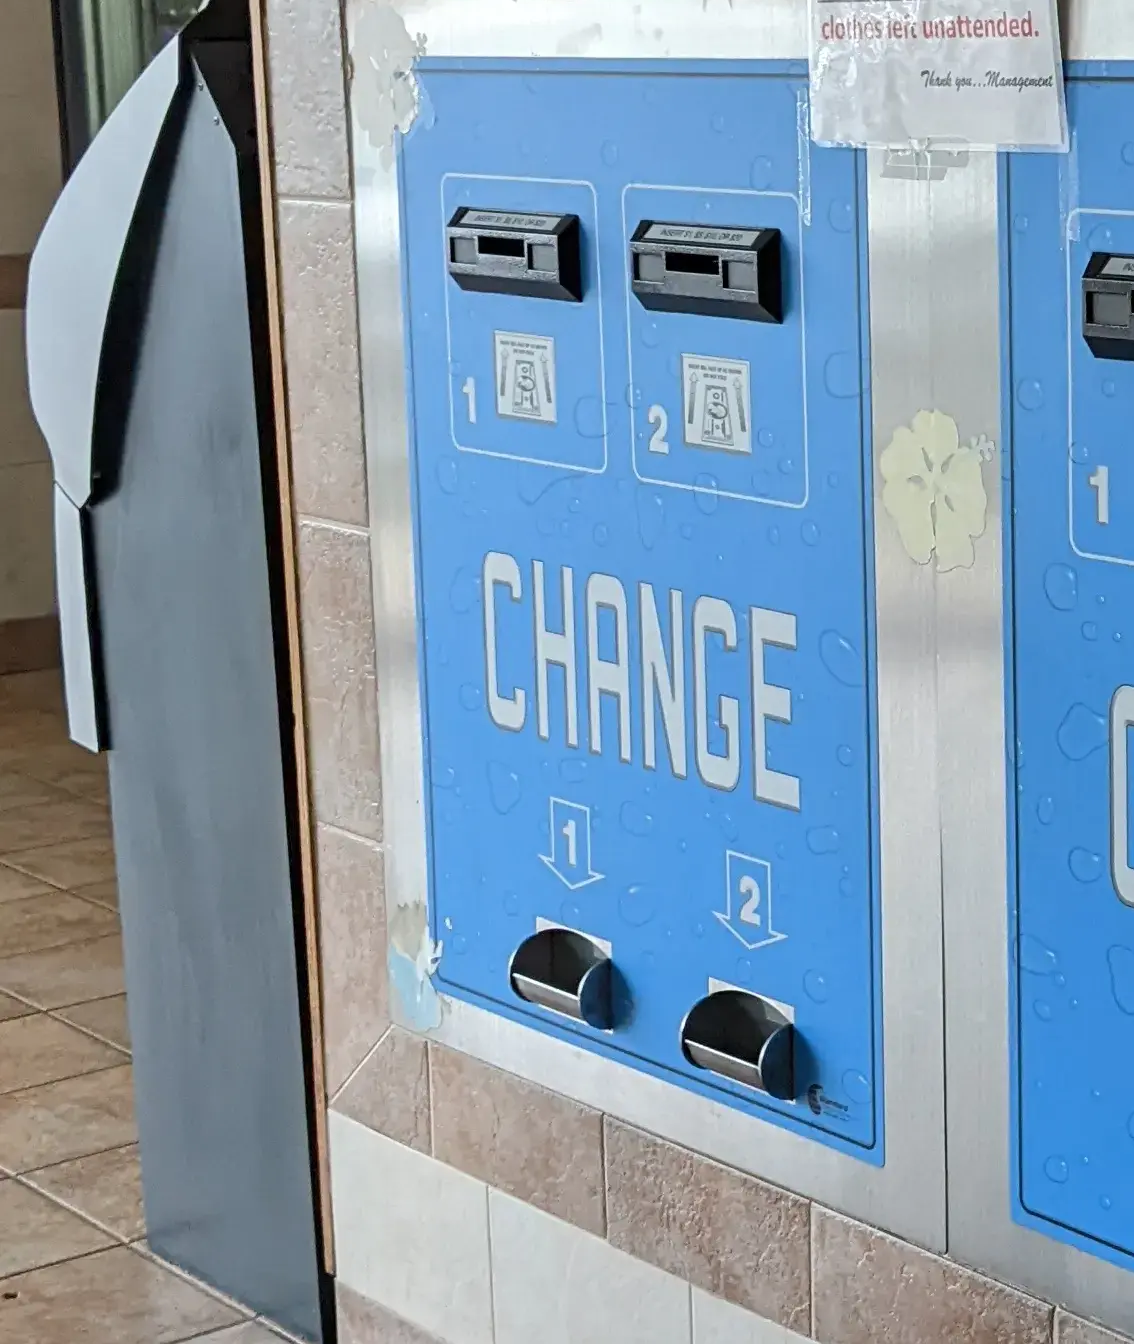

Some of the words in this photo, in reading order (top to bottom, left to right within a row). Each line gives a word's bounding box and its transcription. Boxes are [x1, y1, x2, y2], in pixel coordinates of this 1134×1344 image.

[821, 15, 882, 41] clothes
[922, 10, 1040, 39] unattended.
[920, 69, 953, 90] Thank
[462, 376, 477, 425] 1
[648, 403, 670, 456] 2
[1089, 465, 1109, 525] 1
[481, 550, 801, 812] CHANGE
[561, 818, 577, 866] 1
[738, 873, 762, 927] 2
